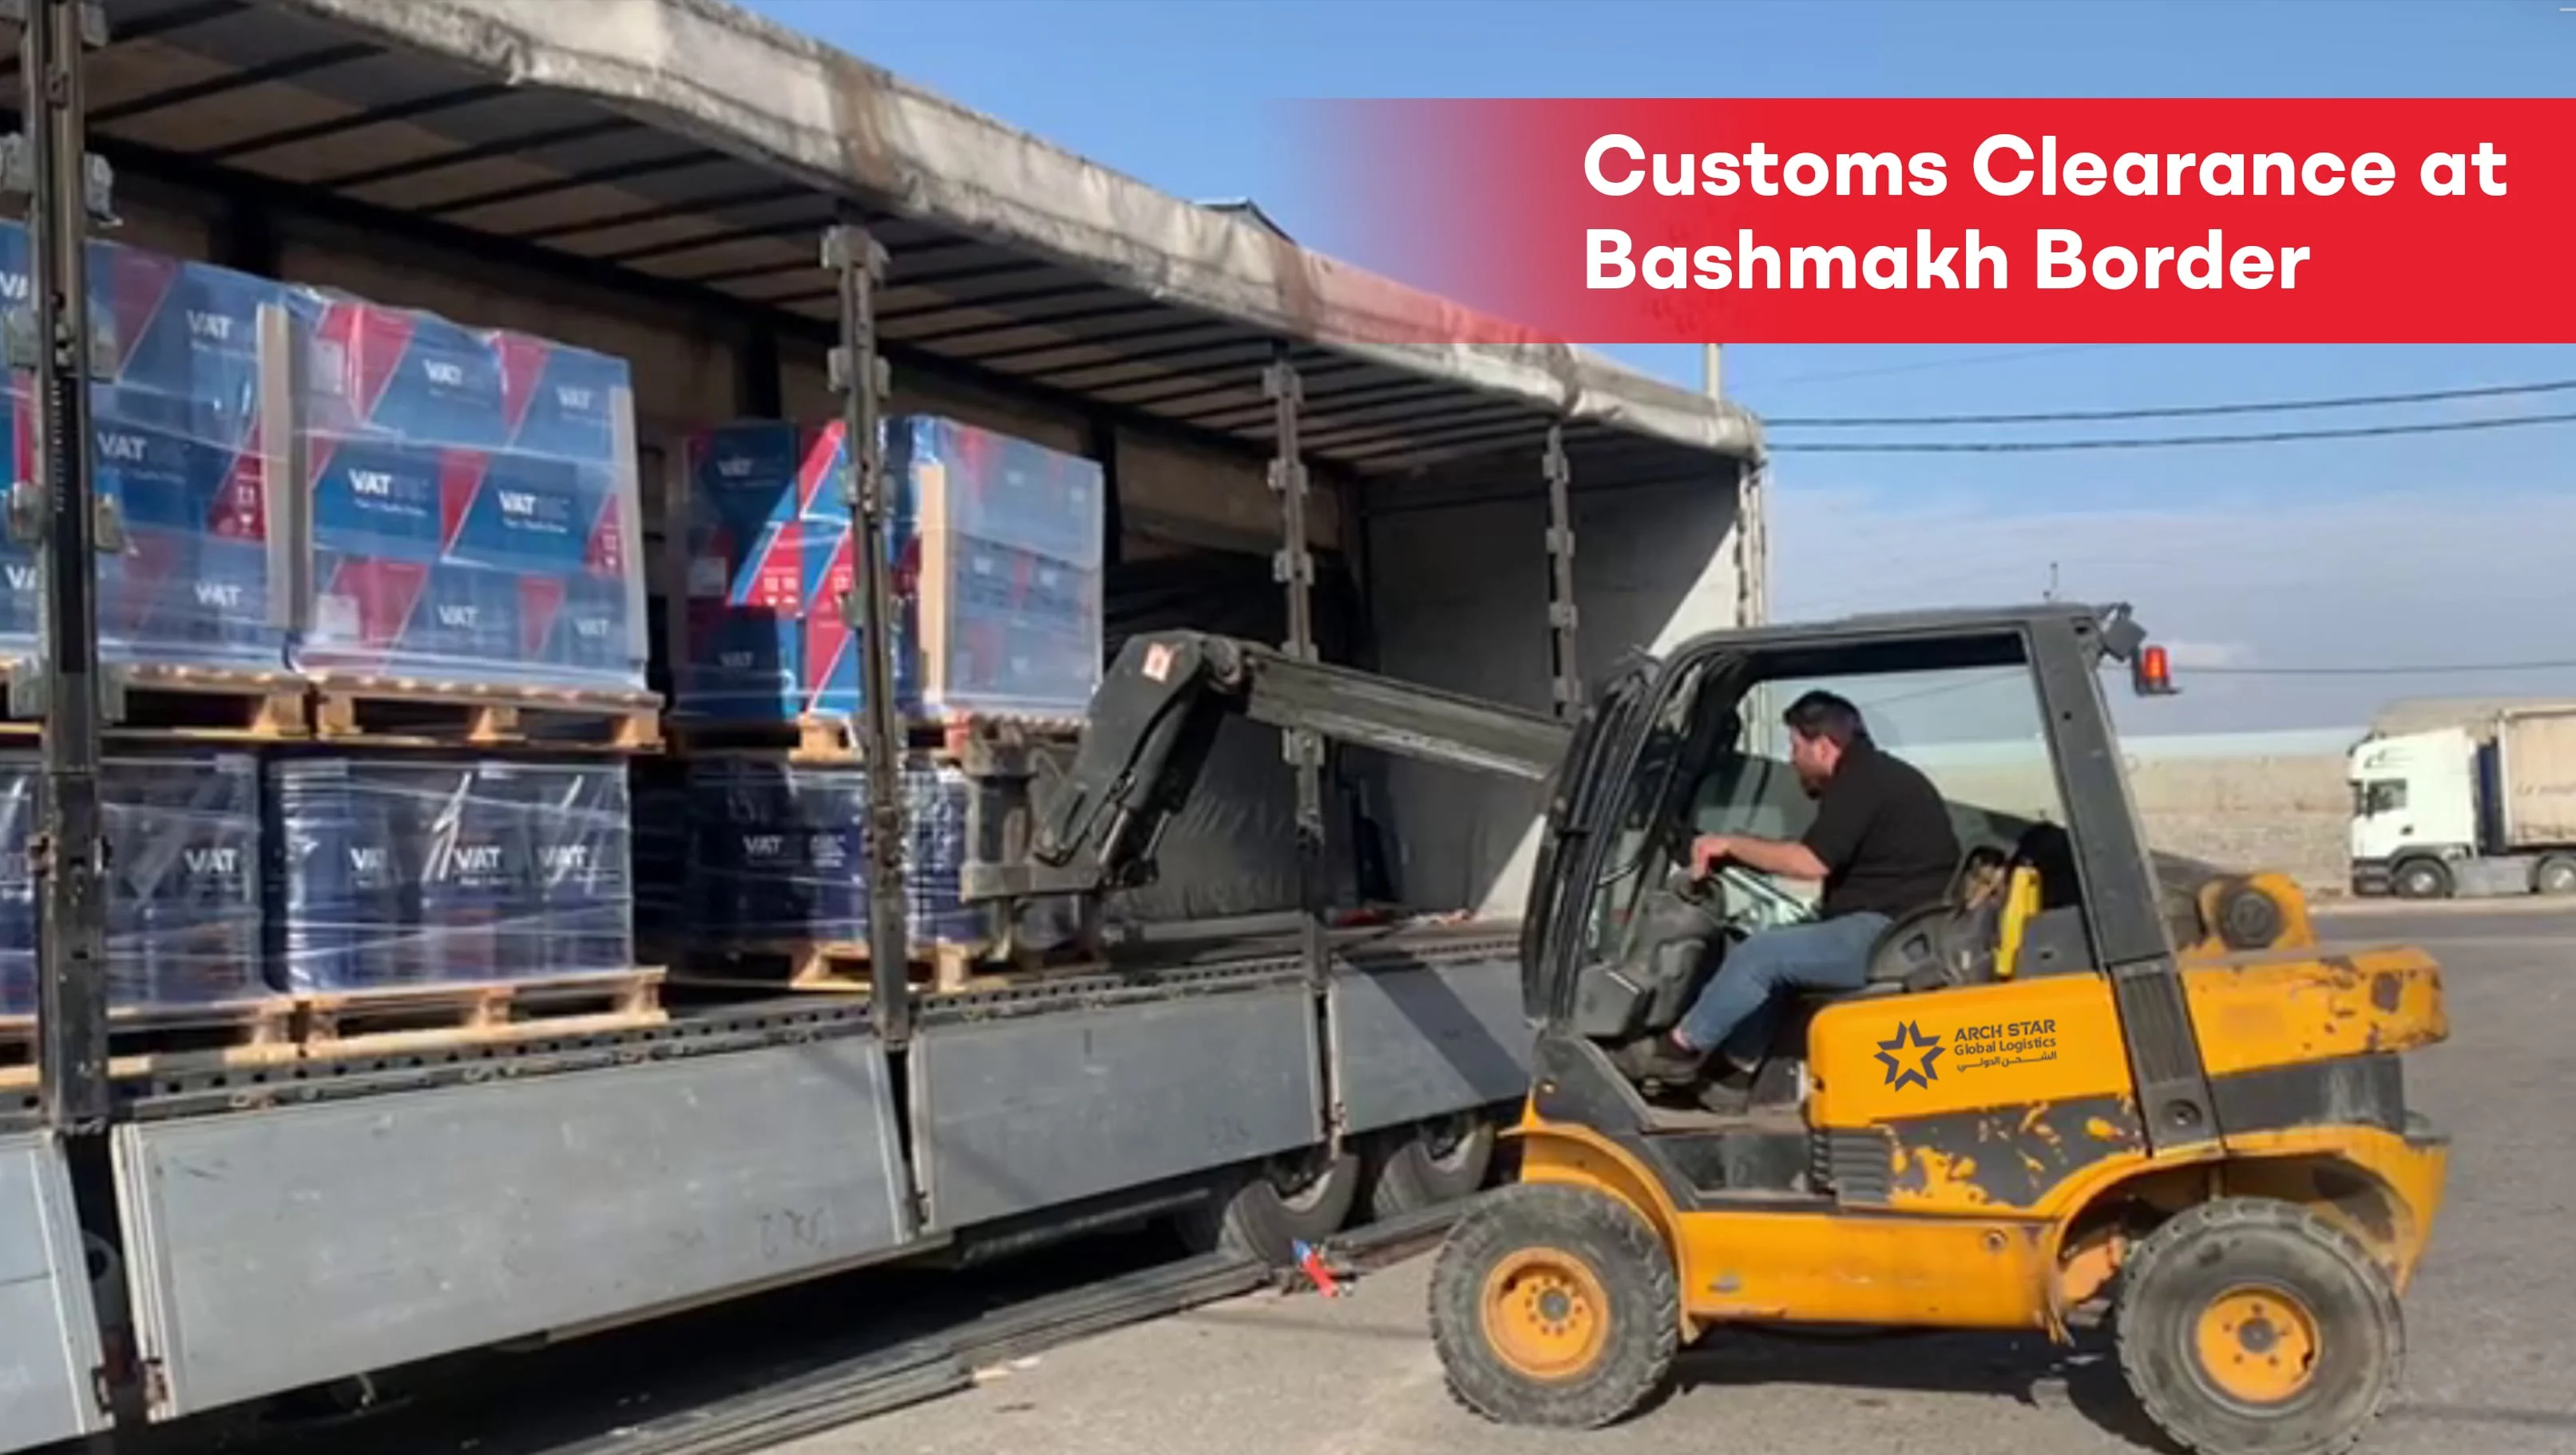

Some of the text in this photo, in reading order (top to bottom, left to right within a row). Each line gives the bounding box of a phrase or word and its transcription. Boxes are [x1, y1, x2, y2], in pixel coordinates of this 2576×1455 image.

[184, 848, 239, 871] VAT
[454, 845, 501, 869] VAT
[1954, 1019, 2056, 1041] ARCH STAR
[1954, 1037, 2056, 1056] Global Logistics
